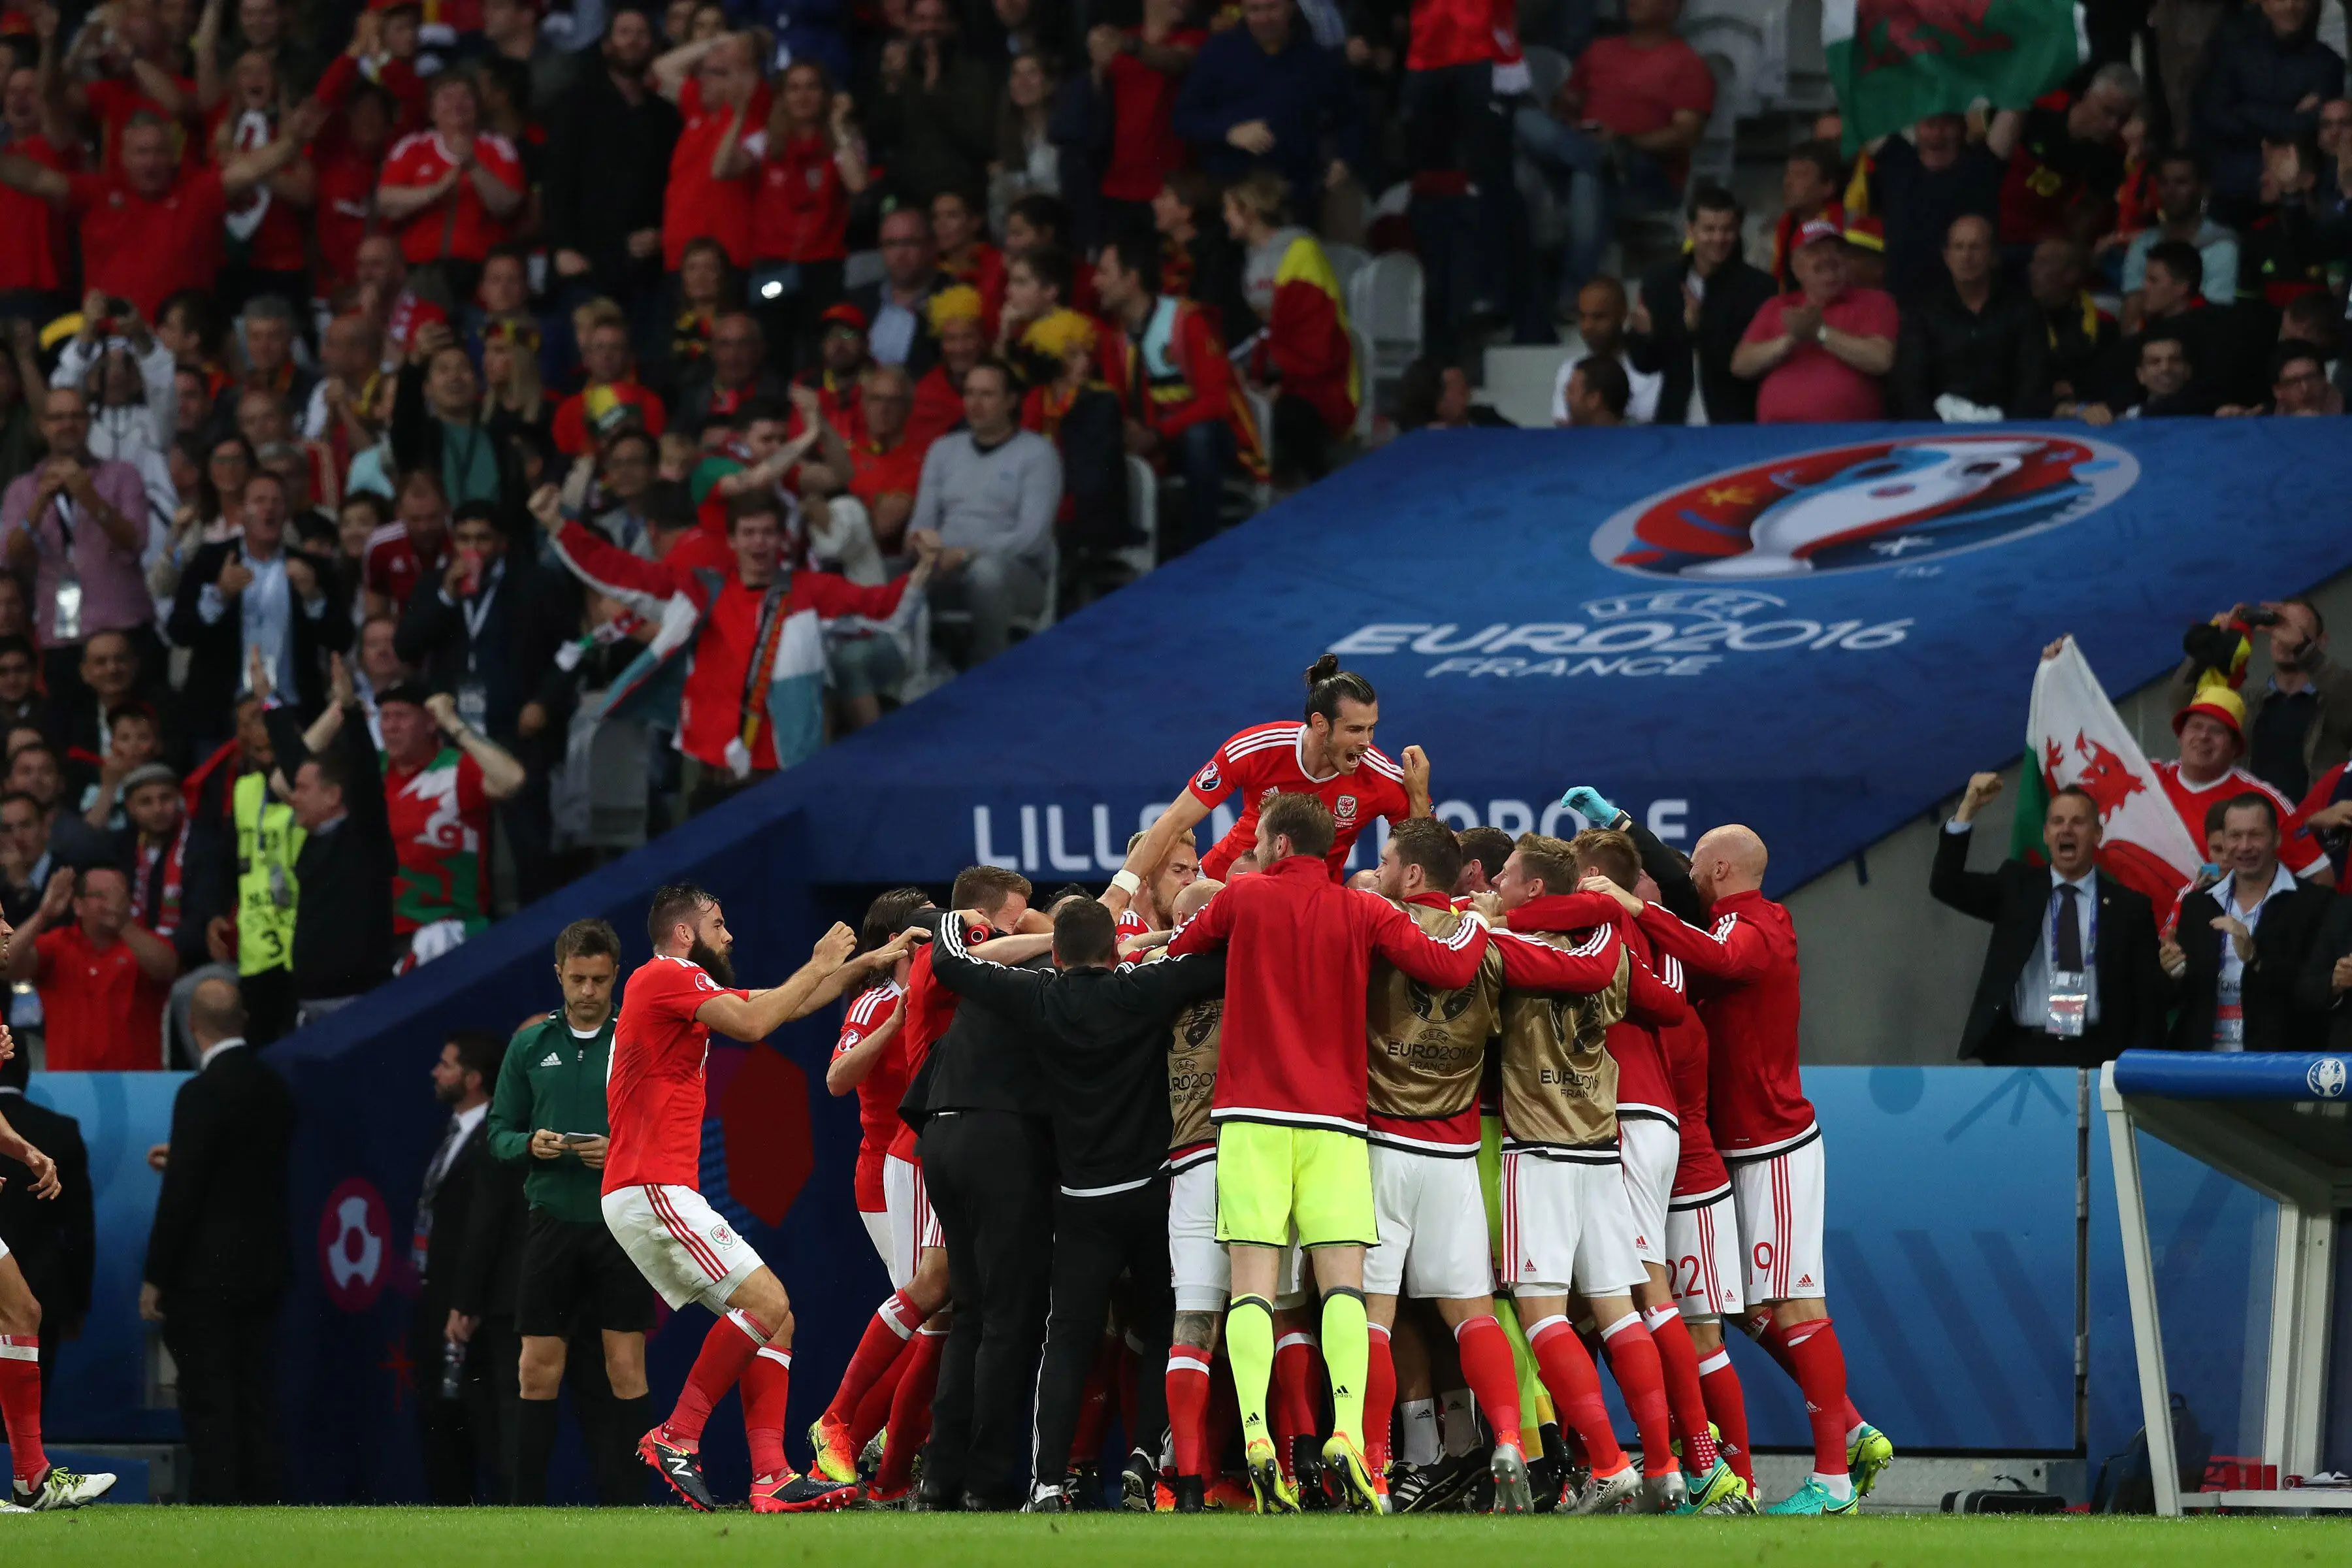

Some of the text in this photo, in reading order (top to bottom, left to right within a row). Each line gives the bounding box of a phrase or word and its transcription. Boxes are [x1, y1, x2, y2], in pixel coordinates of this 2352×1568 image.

[1324, 617, 1915, 654] EURO2016
[1425, 655, 1724, 678] FRANCE
[1420, 1031, 1448, 1043] UEFA
[1386, 1039, 1473, 1060] EURO2016
[1173, 1060, 1196, 1072] UEFA
[1408, 1060, 1452, 1072] FRANCE
[1173, 1091, 1205, 1103] FRANCE
[1560, 1088, 1589, 1098] FRAN
